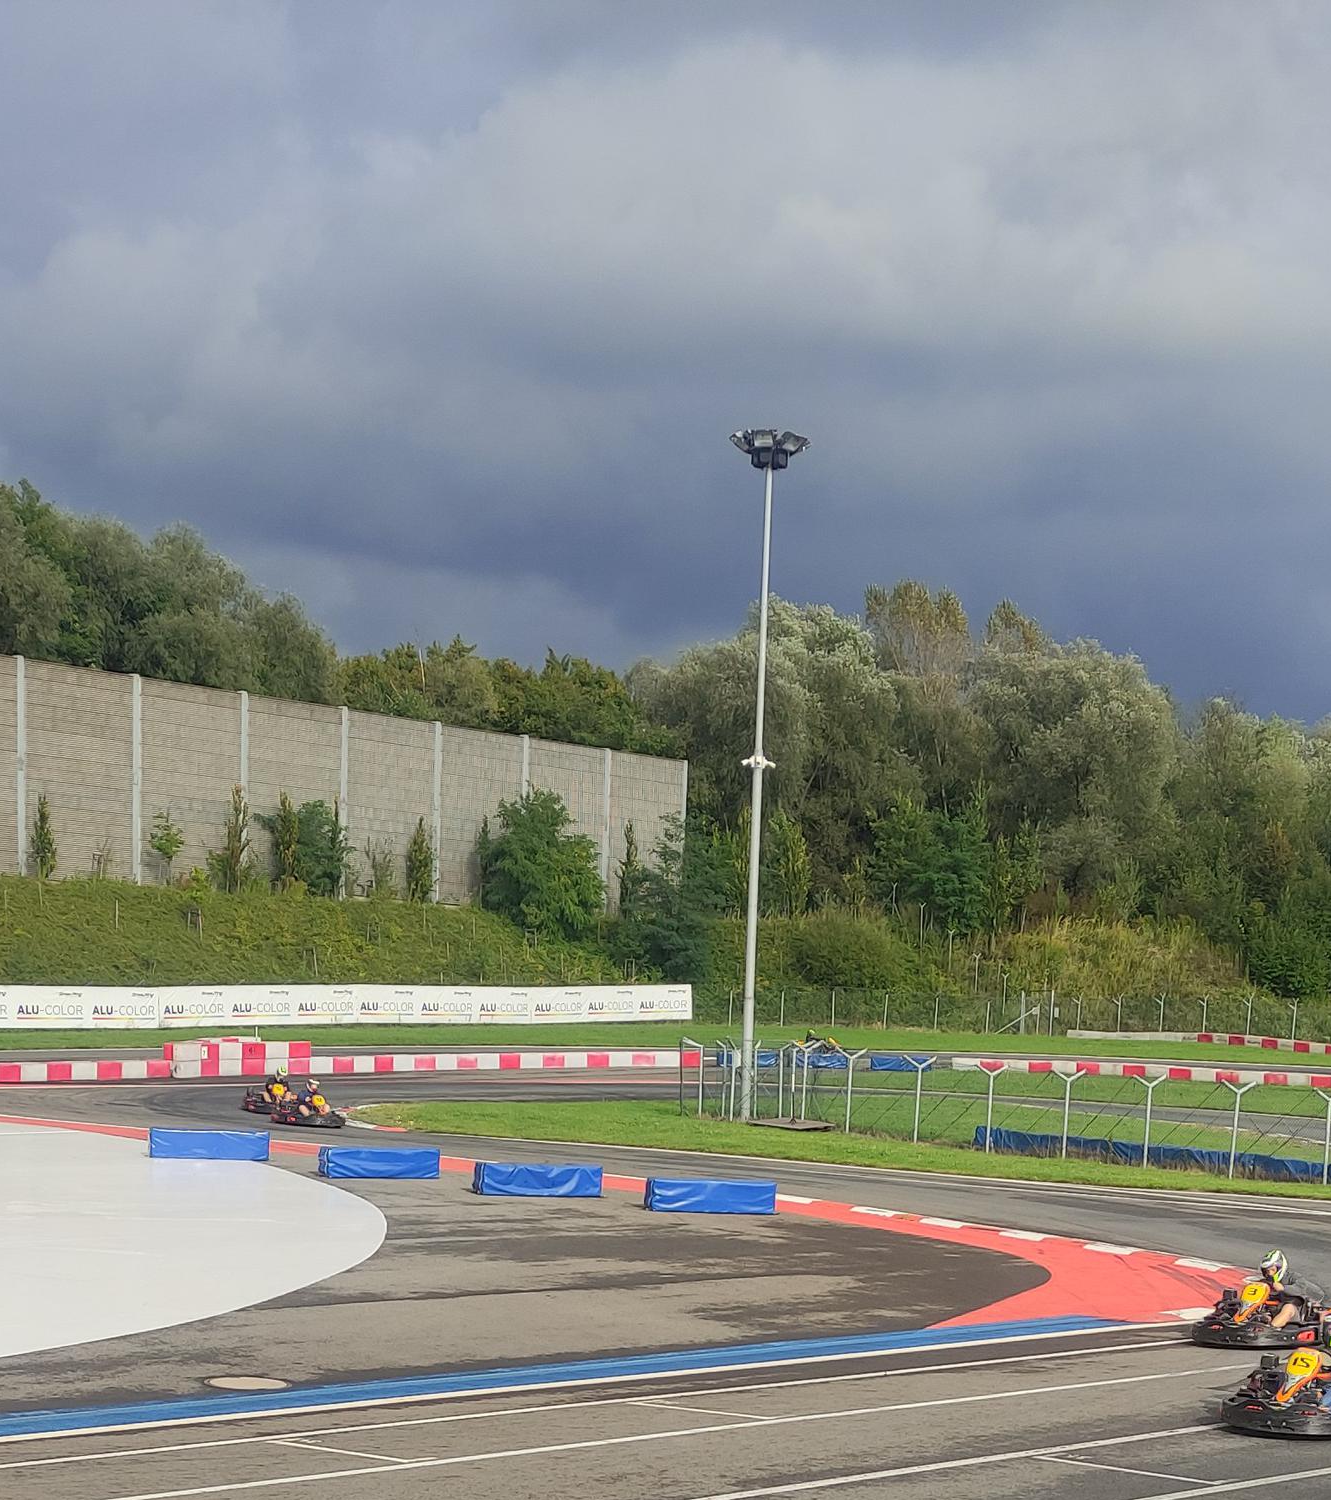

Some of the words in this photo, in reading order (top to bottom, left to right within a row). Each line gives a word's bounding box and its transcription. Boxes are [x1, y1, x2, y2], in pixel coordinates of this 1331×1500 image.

[17, 1004, 83, 1015] ALU-COLOR
[92, 1005, 155, 1016] ALU-COLOR
[164, 1003, 224, 1015] ALU-COLOR
[232, 1002, 290, 1013] ALU-COLOR
[298, 1001, 353, 1012] ALU-COLOR
[360, 1001, 414, 1012] ALU-COLOR
[421, 1002, 472, 1012] ALU-COLOR
[479, 1003, 528, 1012] ALU-COLOR
[535, 1002, 582, 1012] ALU-COLOR
[588, 1000, 634, 1011] ALU-COLOR
[640, 1000, 688, 1010] ALU-COLOR
[1248, 1288, 1257, 1296] 3
[1292, 1357, 1314, 1368] 15
